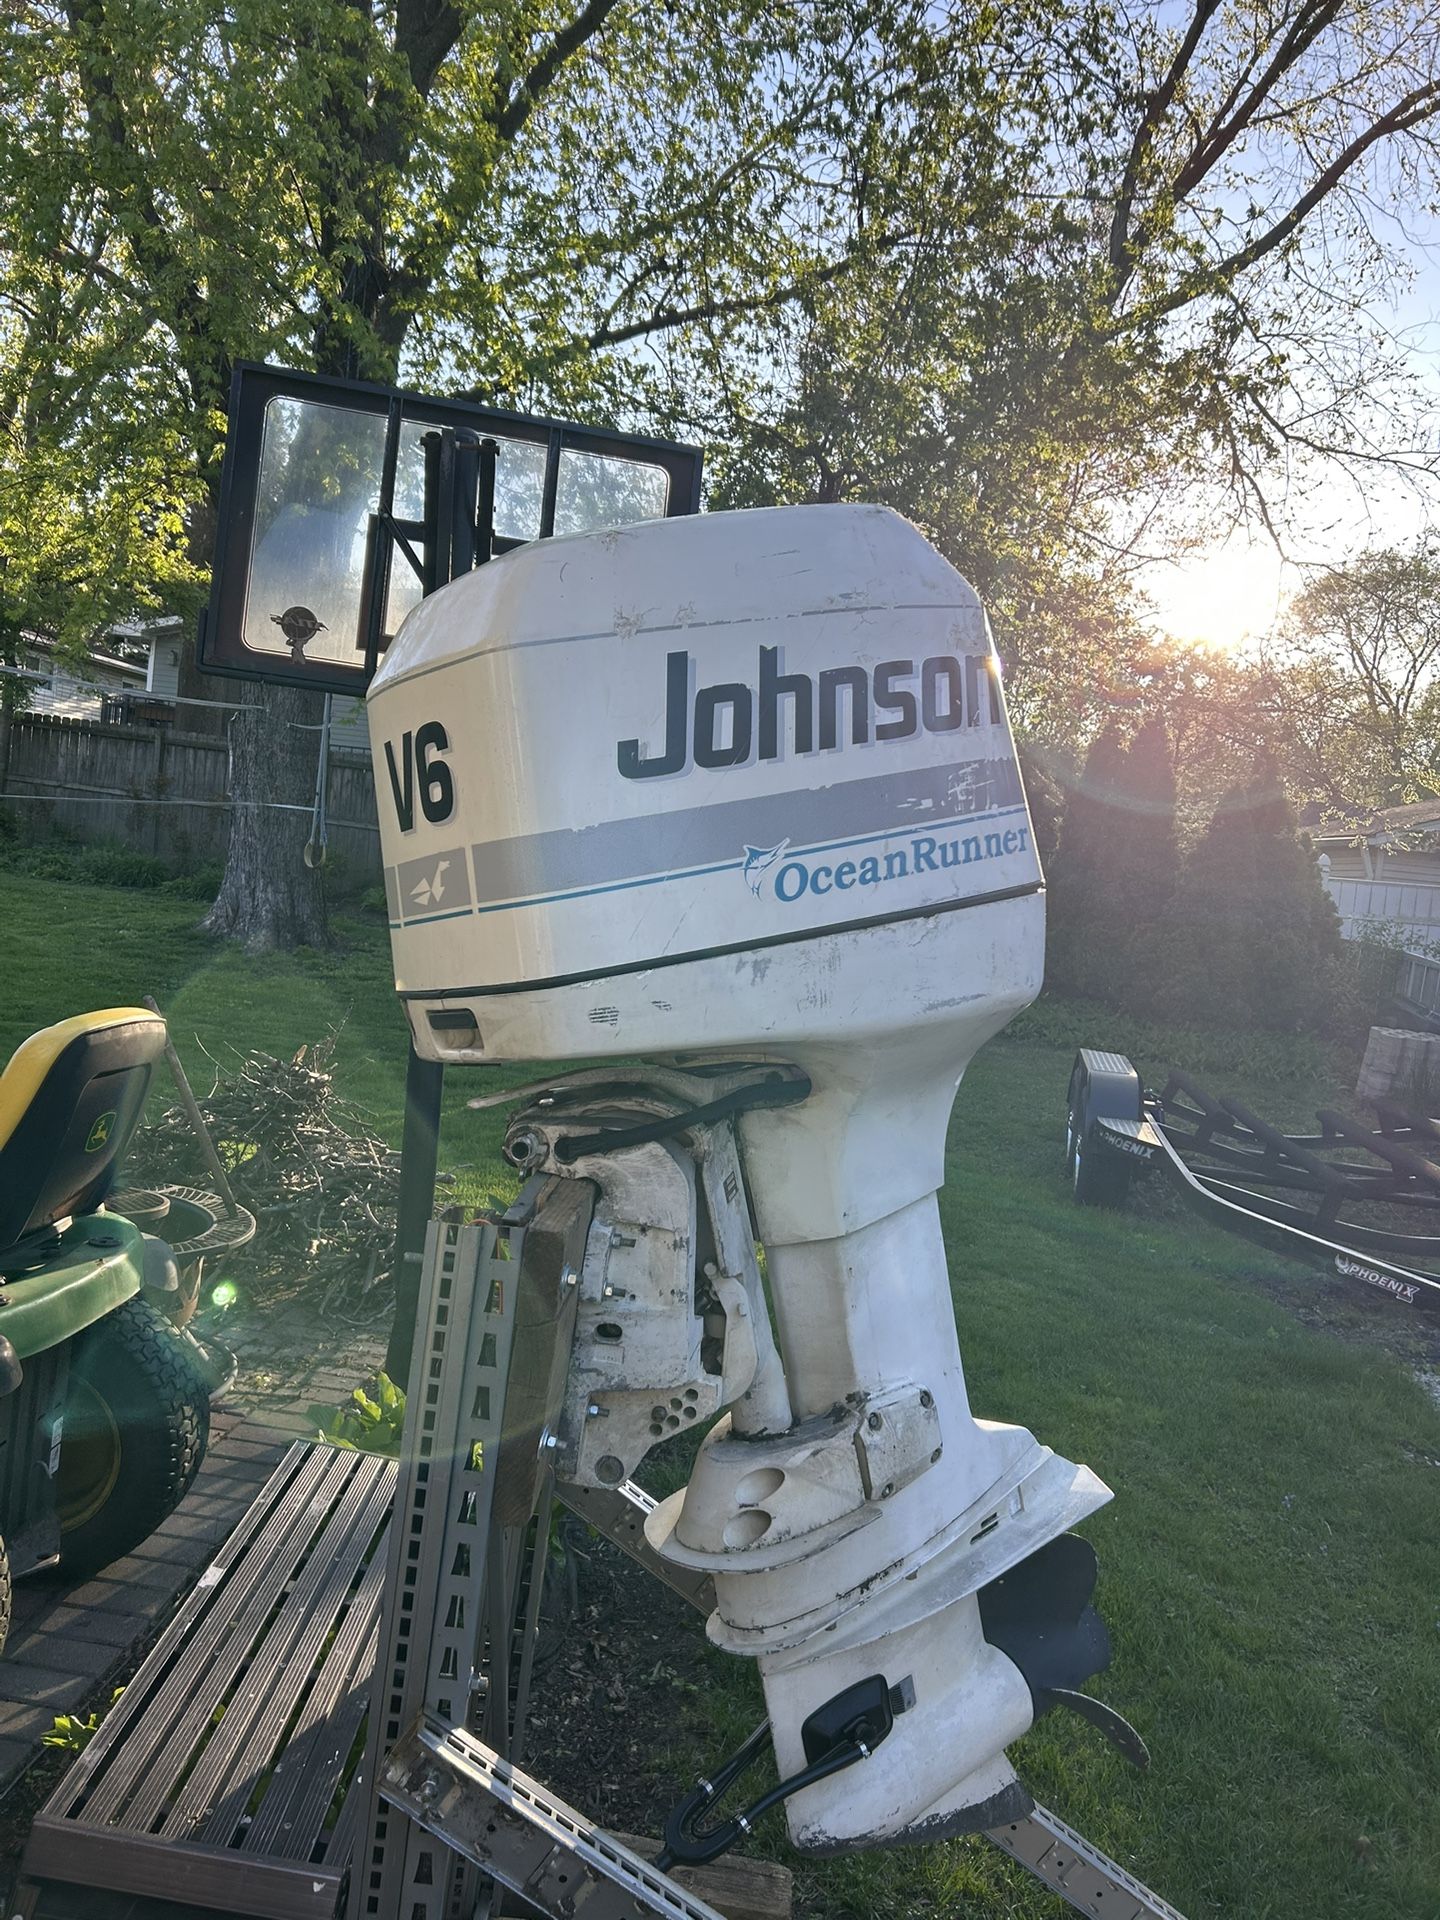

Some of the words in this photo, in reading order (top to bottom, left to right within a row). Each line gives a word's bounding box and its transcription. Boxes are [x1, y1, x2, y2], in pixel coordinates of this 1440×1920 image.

[617, 645, 1001, 781] Johnson
[384, 721, 455, 834] V6
[1349, 1265, 1414, 1297] PHOENIX
